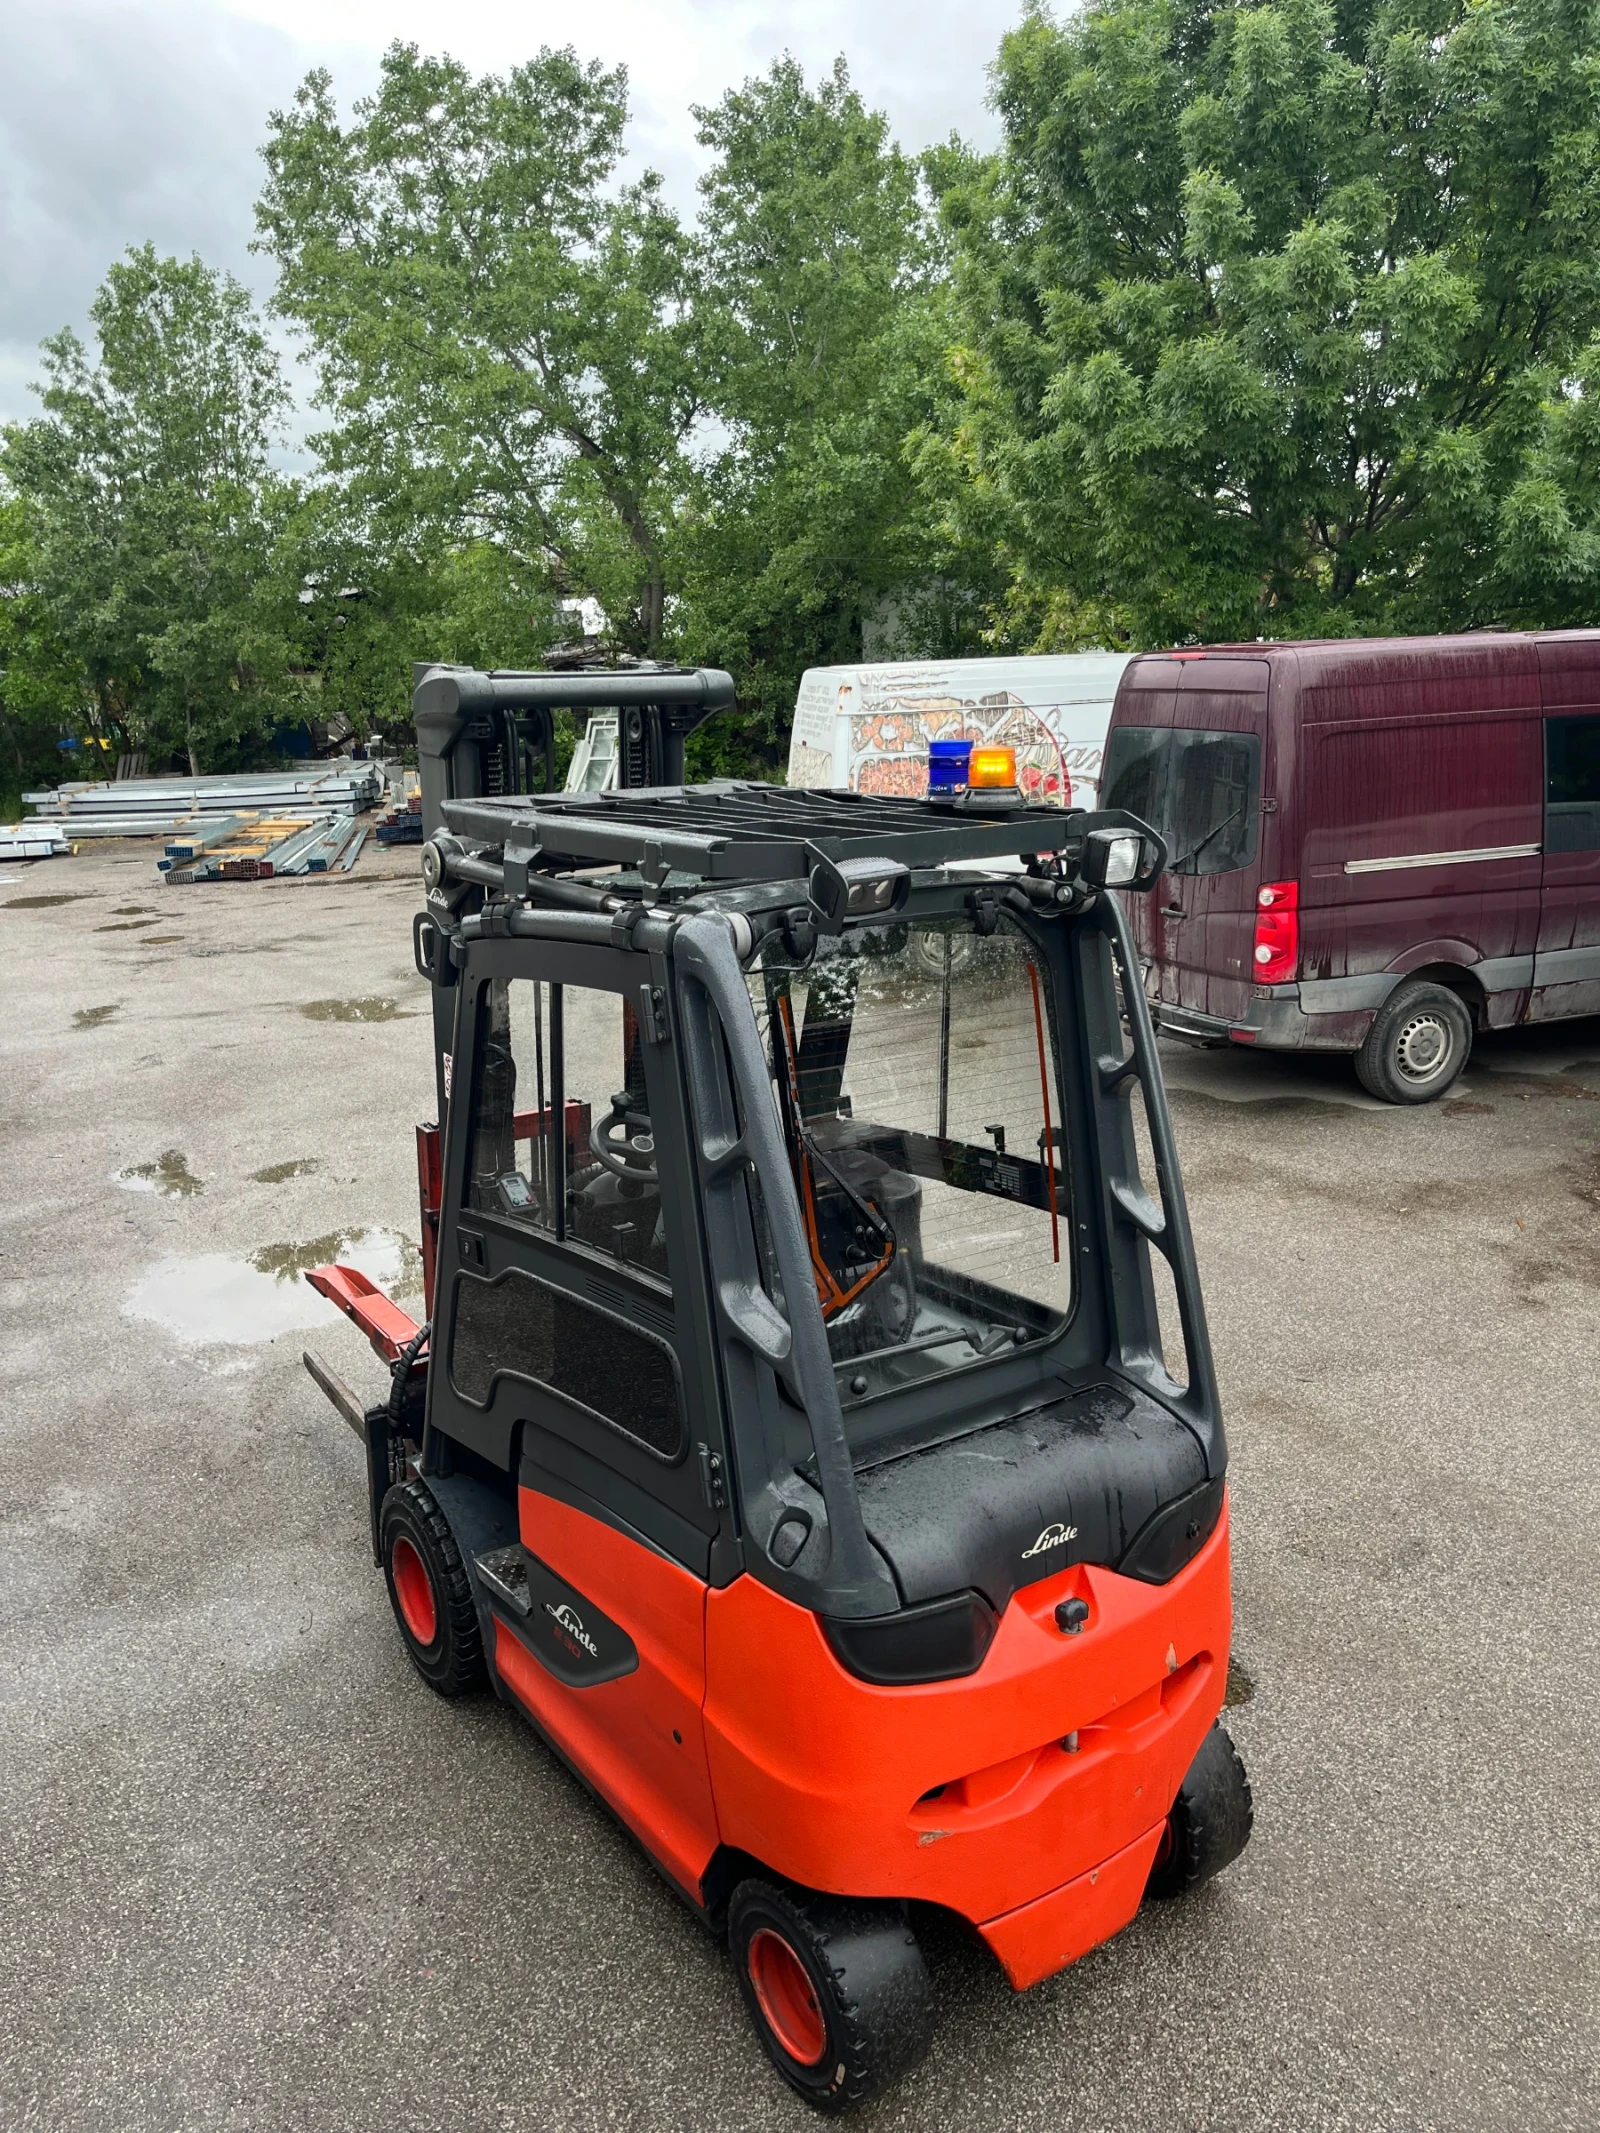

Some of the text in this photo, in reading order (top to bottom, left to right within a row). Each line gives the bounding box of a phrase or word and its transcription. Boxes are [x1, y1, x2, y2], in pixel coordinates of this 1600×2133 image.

[425, 887, 449, 909] Linde
[1021, 1523, 1078, 1559] Linde
[546, 1604, 598, 1657] Linde
